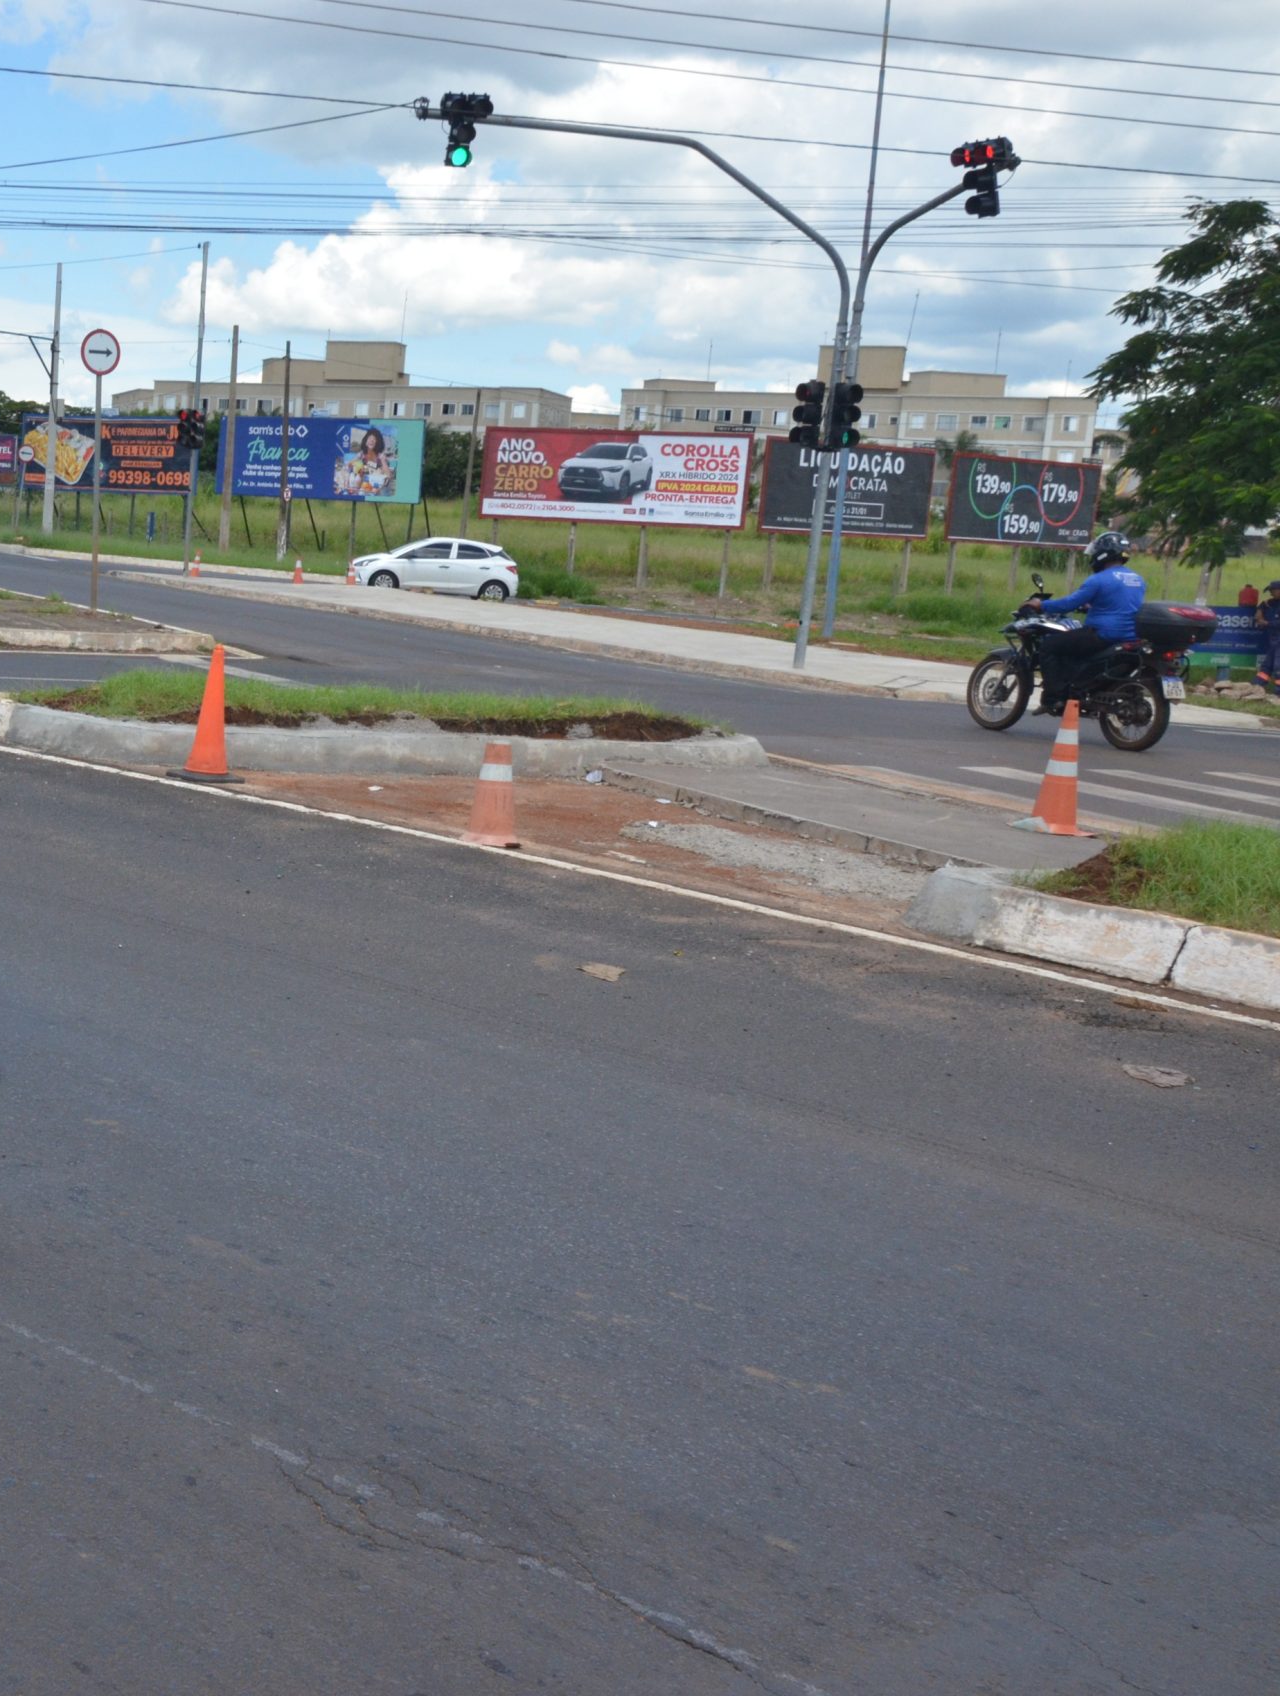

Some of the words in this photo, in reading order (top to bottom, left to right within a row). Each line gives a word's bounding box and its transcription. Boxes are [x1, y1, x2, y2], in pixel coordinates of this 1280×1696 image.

[248, 425, 274, 436] sam's
[274, 425, 295, 436] clb
[114, 446, 172, 456] DELIVERY
[499, 438, 535, 451] ANO
[660, 443, 740, 458] COROLLA
[497, 451, 548, 466] NOVO,
[683, 458, 740, 472] CROSS
[108, 470, 191, 486] 99398-0698
[495, 464, 554, 479] CARRO
[659, 471, 677, 479] XRX
[718, 473, 739, 481] 2024
[494, 477, 538, 491] ZERO
[657, 481, 679, 491] IPVA
[679, 482, 702, 492] 2024
[975, 474, 1011, 495] 139,90
[644, 493, 736, 505] PRONTA-ENTREGA
[1042, 483, 1078, 504] 179,90
[1003, 514, 1040, 534] 159,90
